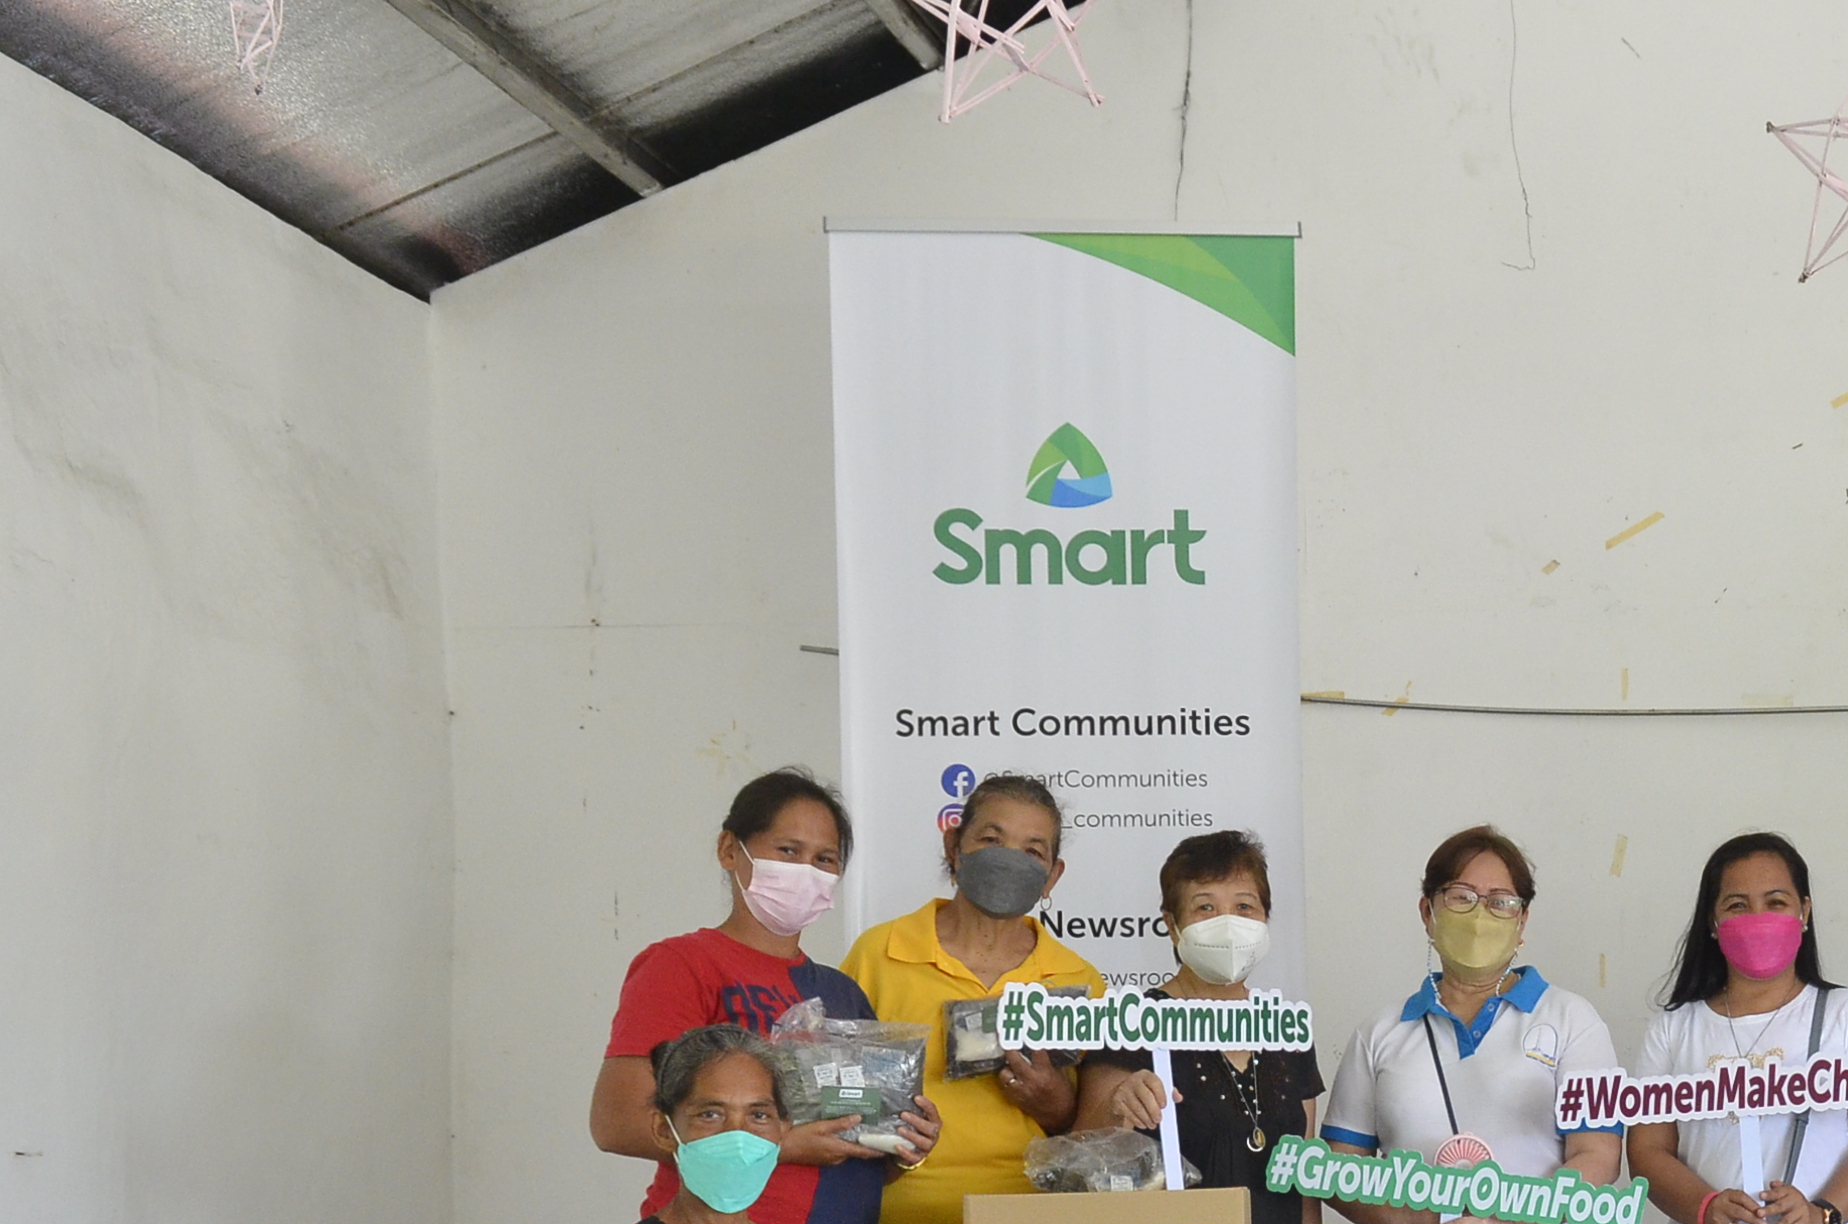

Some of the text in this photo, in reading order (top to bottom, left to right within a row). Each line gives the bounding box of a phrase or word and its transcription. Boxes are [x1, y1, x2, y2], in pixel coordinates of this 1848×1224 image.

[932, 508, 1207, 585] Smart
[896, 707, 1251, 738] Smart Communities
[1061, 807, 1213, 828] _communities
[1040, 910, 1170, 938] Newsro
[1003, 990, 1310, 1043] #SmartCommunities
